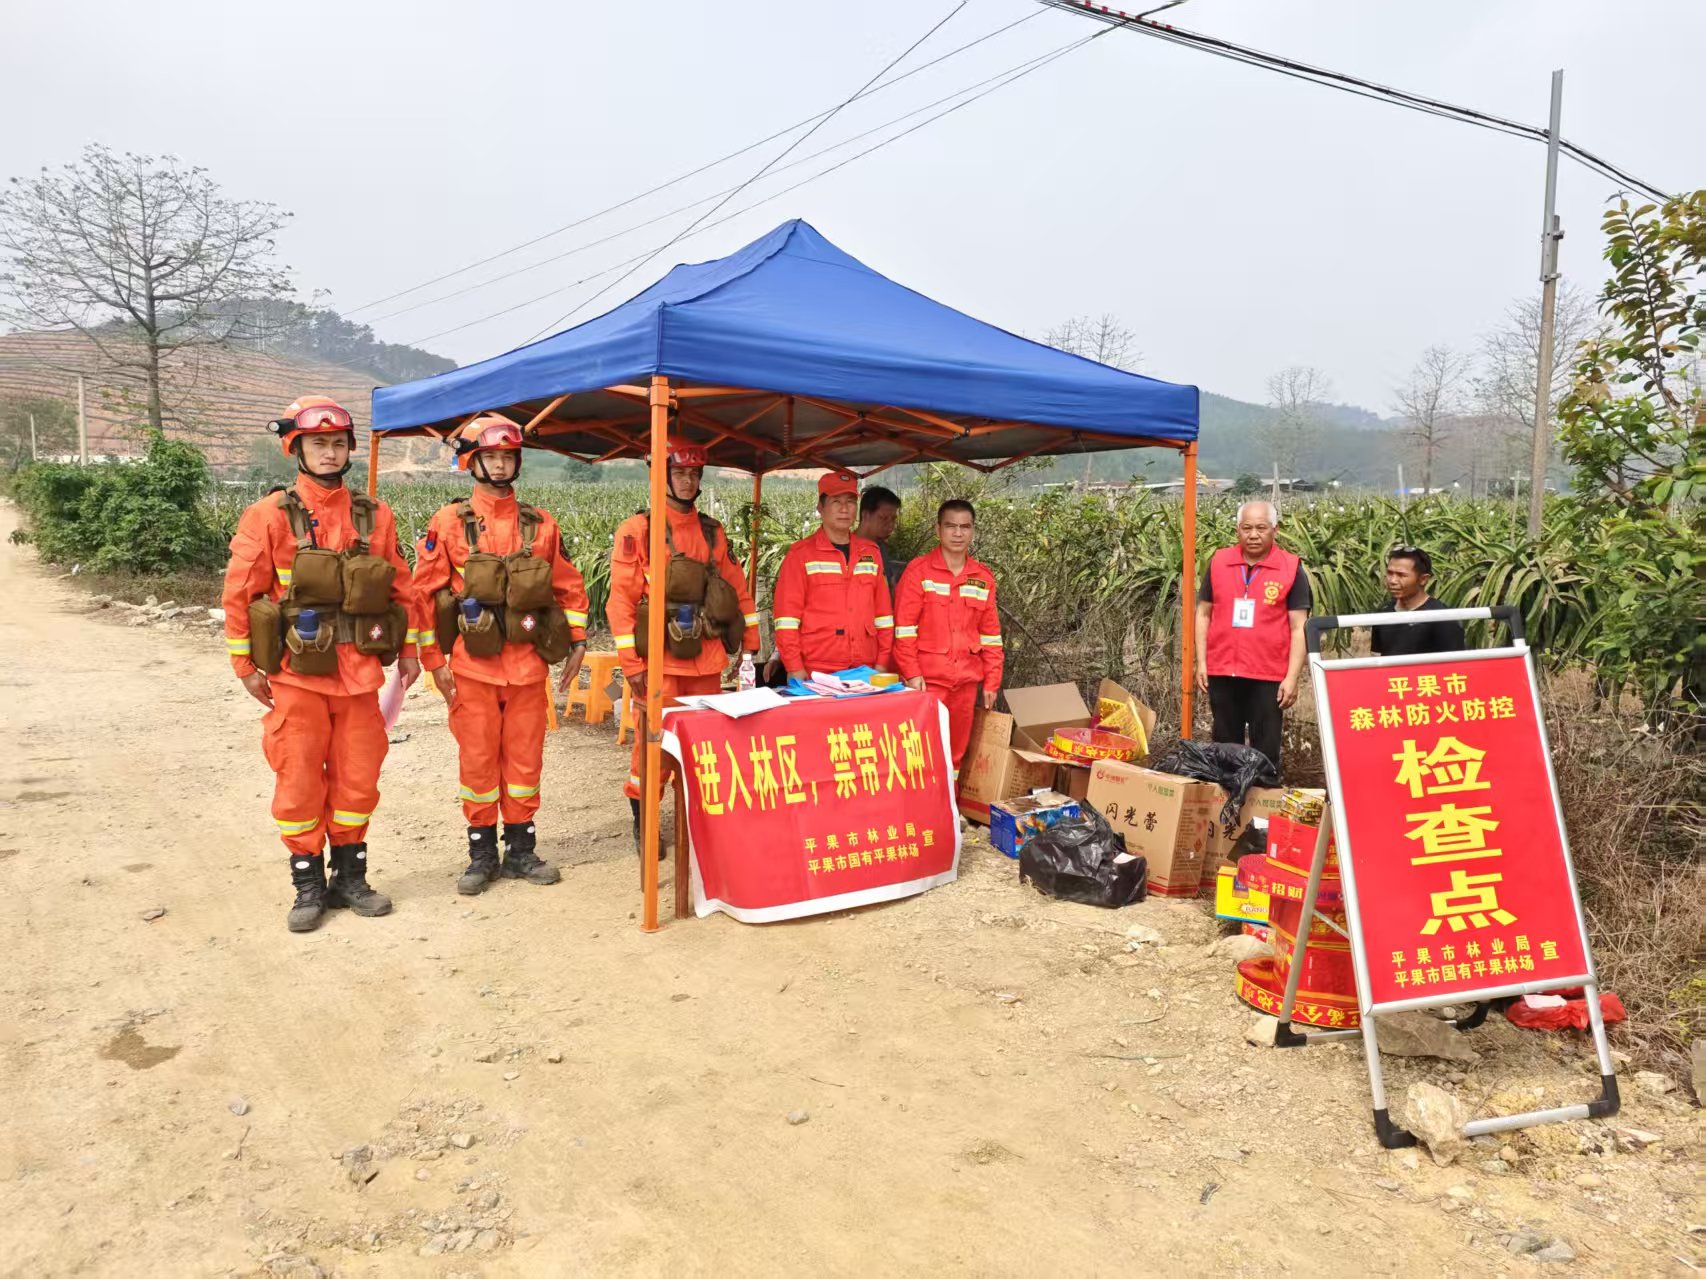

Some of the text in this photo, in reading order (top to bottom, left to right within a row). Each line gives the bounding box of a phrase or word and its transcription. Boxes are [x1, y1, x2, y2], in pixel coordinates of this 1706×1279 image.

[1388, 672, 1469, 699] 平果市
[1350, 696, 1517, 731] 森林防火防控
[804, 822, 917, 854] 平果市林业局
[921, 829, 935, 847] 宣
[1392, 736, 1518, 934] 检查点
[807, 843, 920, 876] 平果市国有平果林场
[1391, 935, 1531, 969] 平果市林业局
[1540, 940, 1560, 961] 宣
[1394, 954, 1536, 988] 平果市国有平果林场
